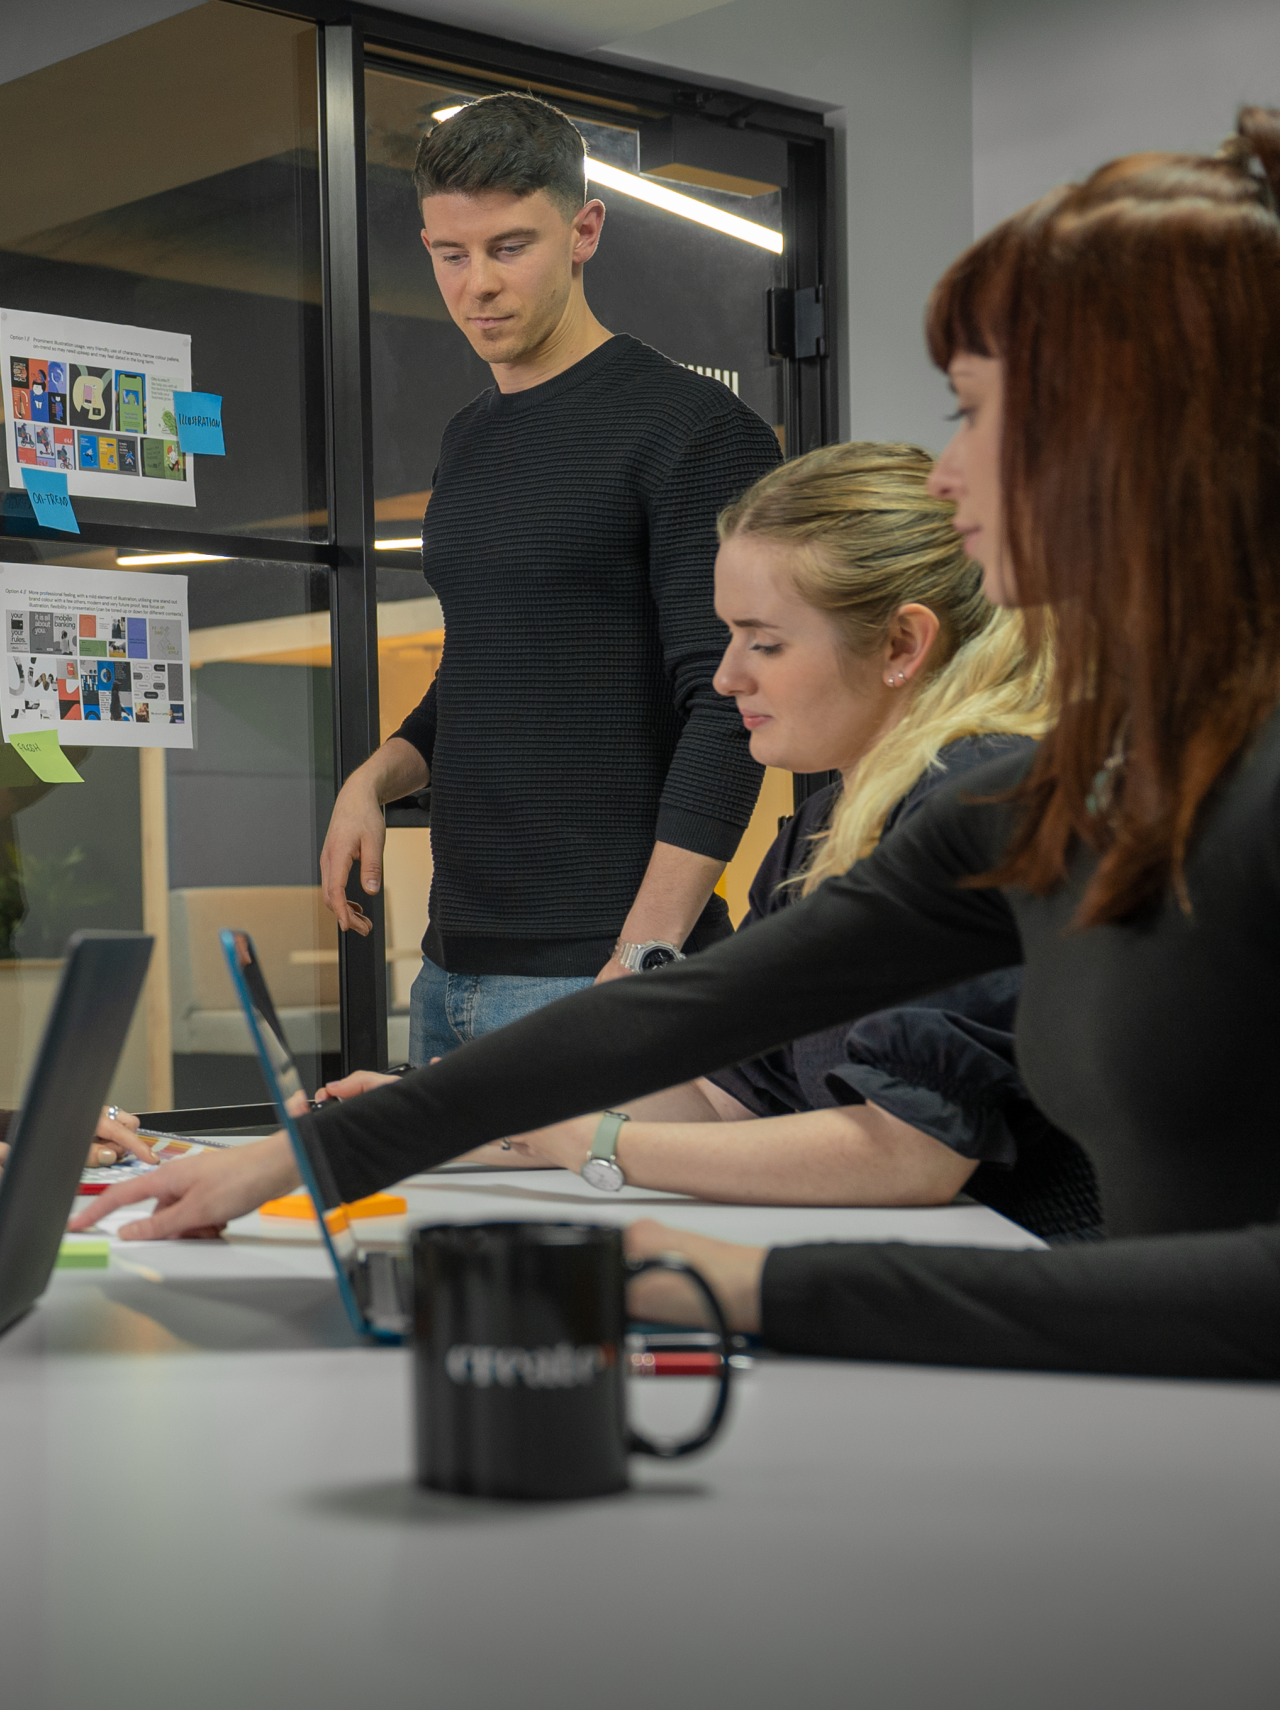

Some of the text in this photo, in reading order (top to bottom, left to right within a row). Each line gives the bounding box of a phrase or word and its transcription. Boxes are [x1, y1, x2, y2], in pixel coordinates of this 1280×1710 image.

[179, 413, 220, 428] ILLUSTRATION
[54, 622, 75, 630] banking
[17, 742, 41, 752] FRESH
